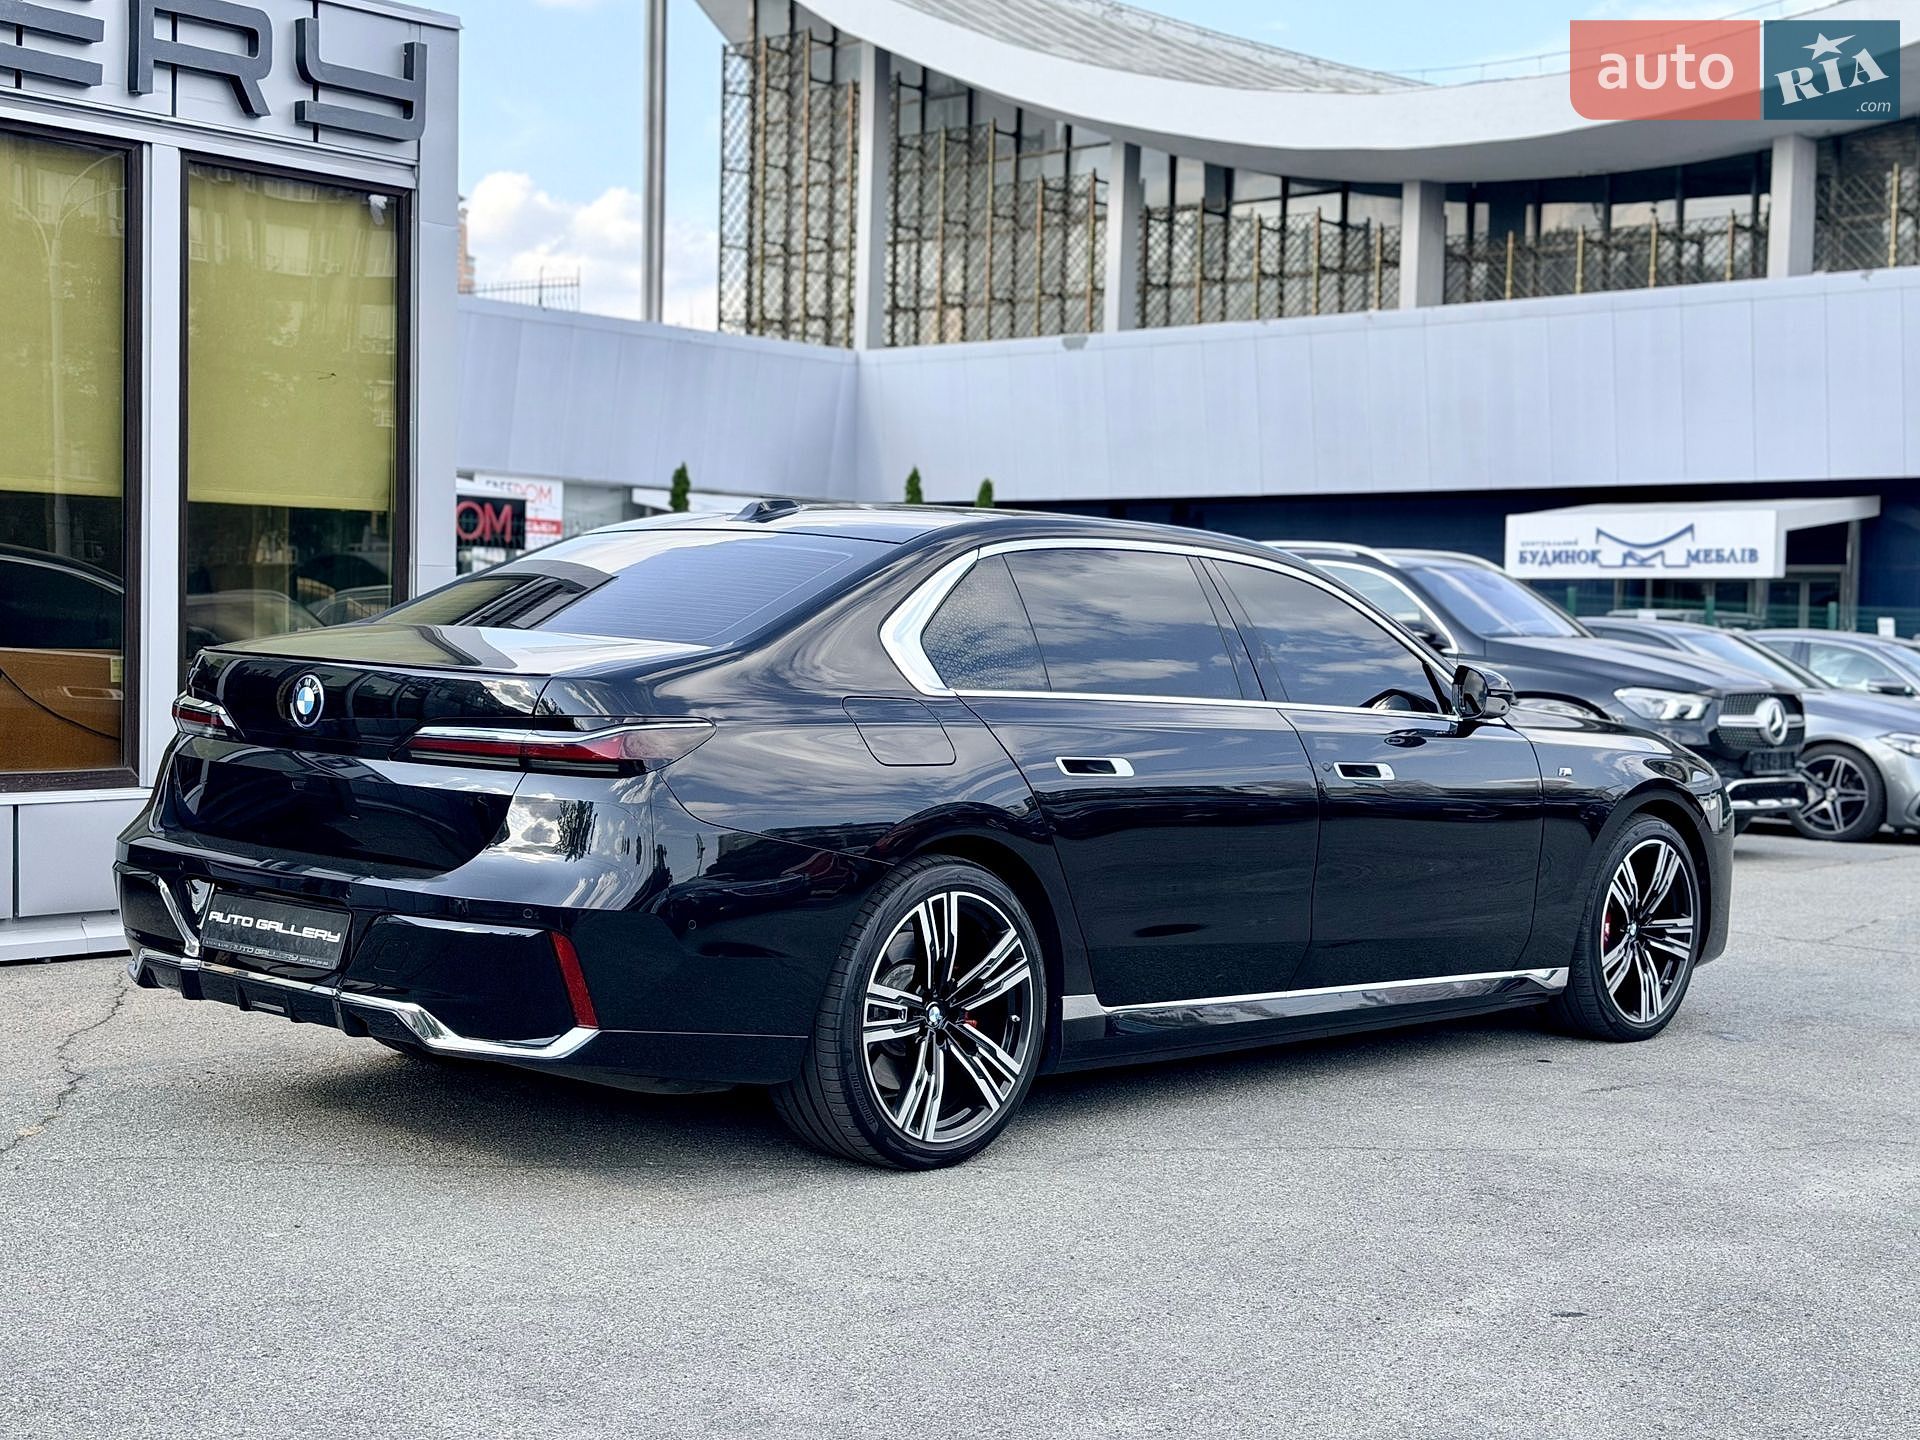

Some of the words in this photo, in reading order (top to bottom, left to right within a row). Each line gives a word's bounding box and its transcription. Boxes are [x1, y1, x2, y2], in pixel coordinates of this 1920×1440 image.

[1518, 549, 1602, 566] БУДИНОК
[1686, 548, 1759, 564] МЕБЛІВ
[208, 911, 254, 927] AUTO
[255, 919, 341, 943] GALLERY
